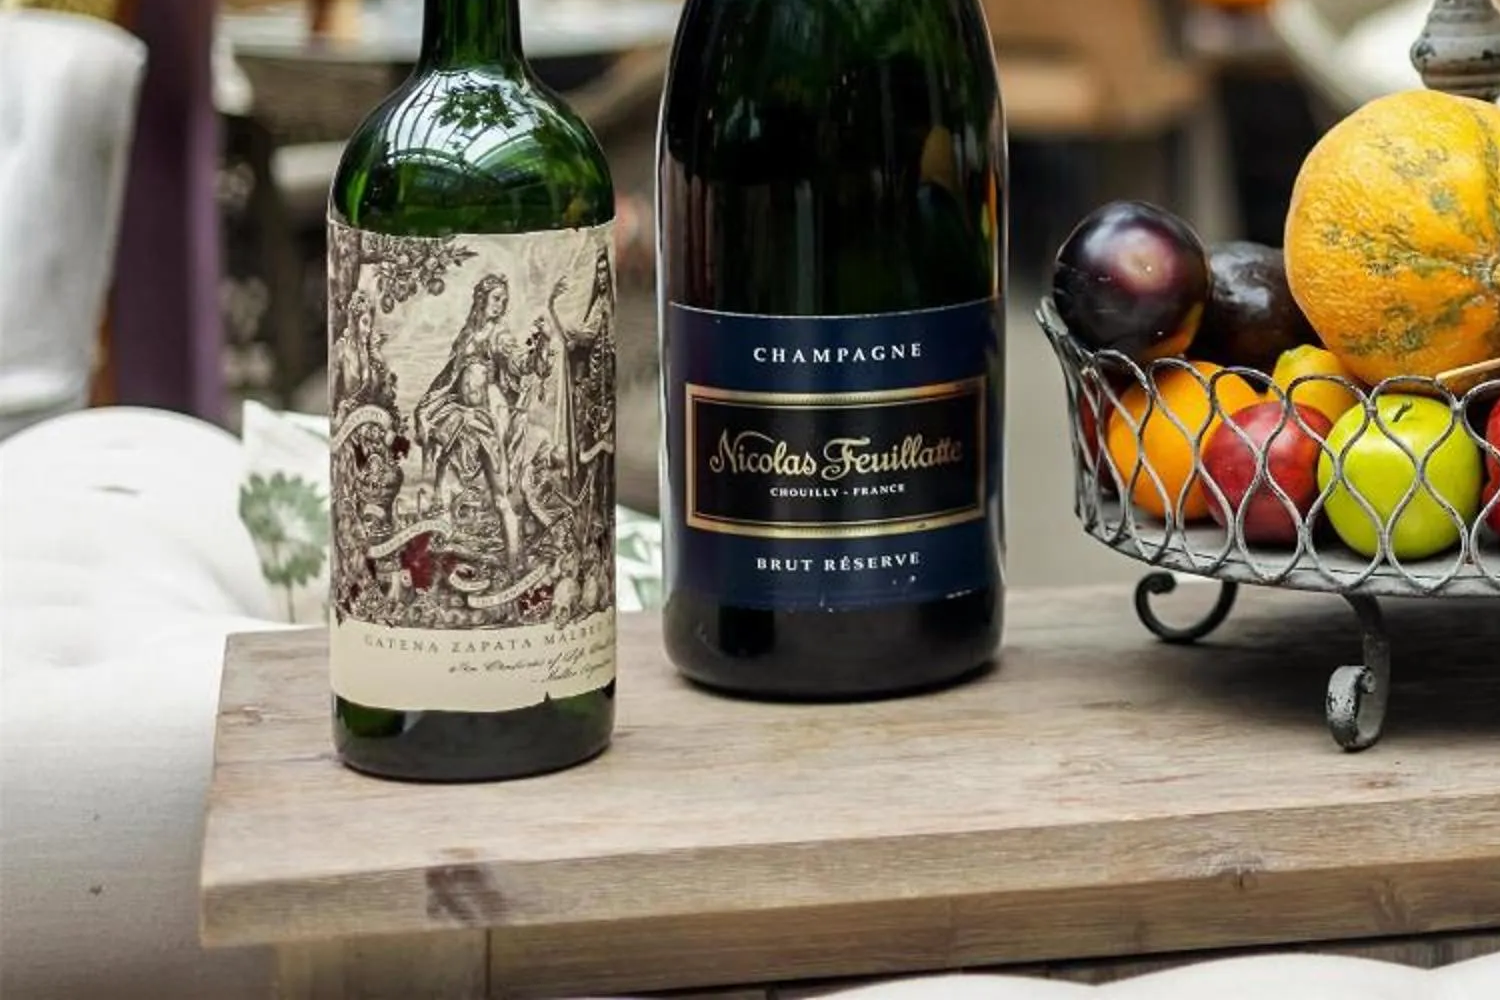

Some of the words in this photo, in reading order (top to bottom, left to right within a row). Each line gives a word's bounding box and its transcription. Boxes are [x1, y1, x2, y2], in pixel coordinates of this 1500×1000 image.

[753, 343, 922, 363] CHAMPAGNE
[709, 428, 817, 477] Nicolas
[821, 433, 963, 481] Feuillatte
[770, 486, 839, 497] CHOUILLY
[853, 483, 905, 497] FRANCE
[757, 557, 813, 572] BRUT
[824, 551, 921, 571] RÉSERVE
[364, 634, 439, 653] CATENA
[451, 638, 532, 653] ZAPATA
